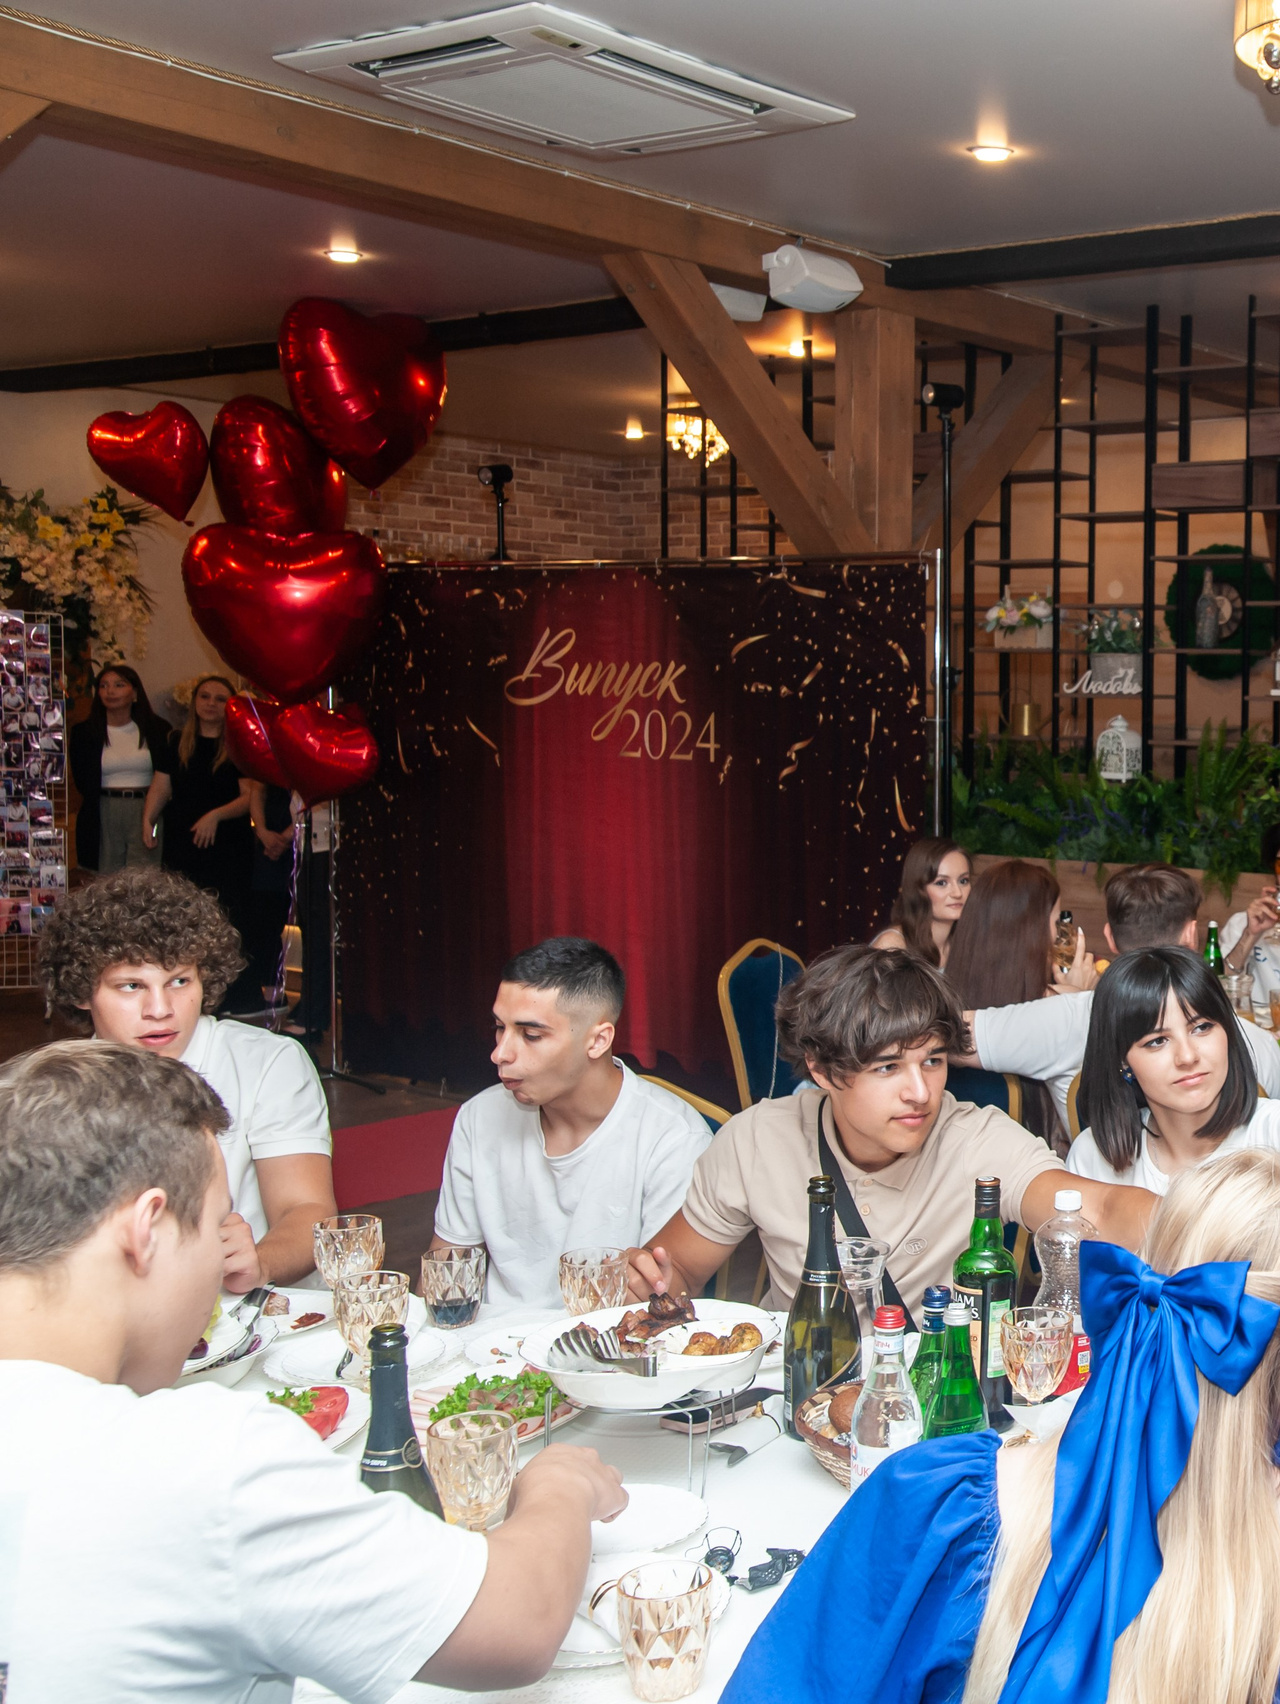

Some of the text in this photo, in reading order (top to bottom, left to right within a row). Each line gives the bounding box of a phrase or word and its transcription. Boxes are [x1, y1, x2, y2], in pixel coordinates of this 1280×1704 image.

[504, 626, 687, 741] Выпуск
[1062, 667, 1143, 694] Любовь
[618, 708, 721, 763] 2024
